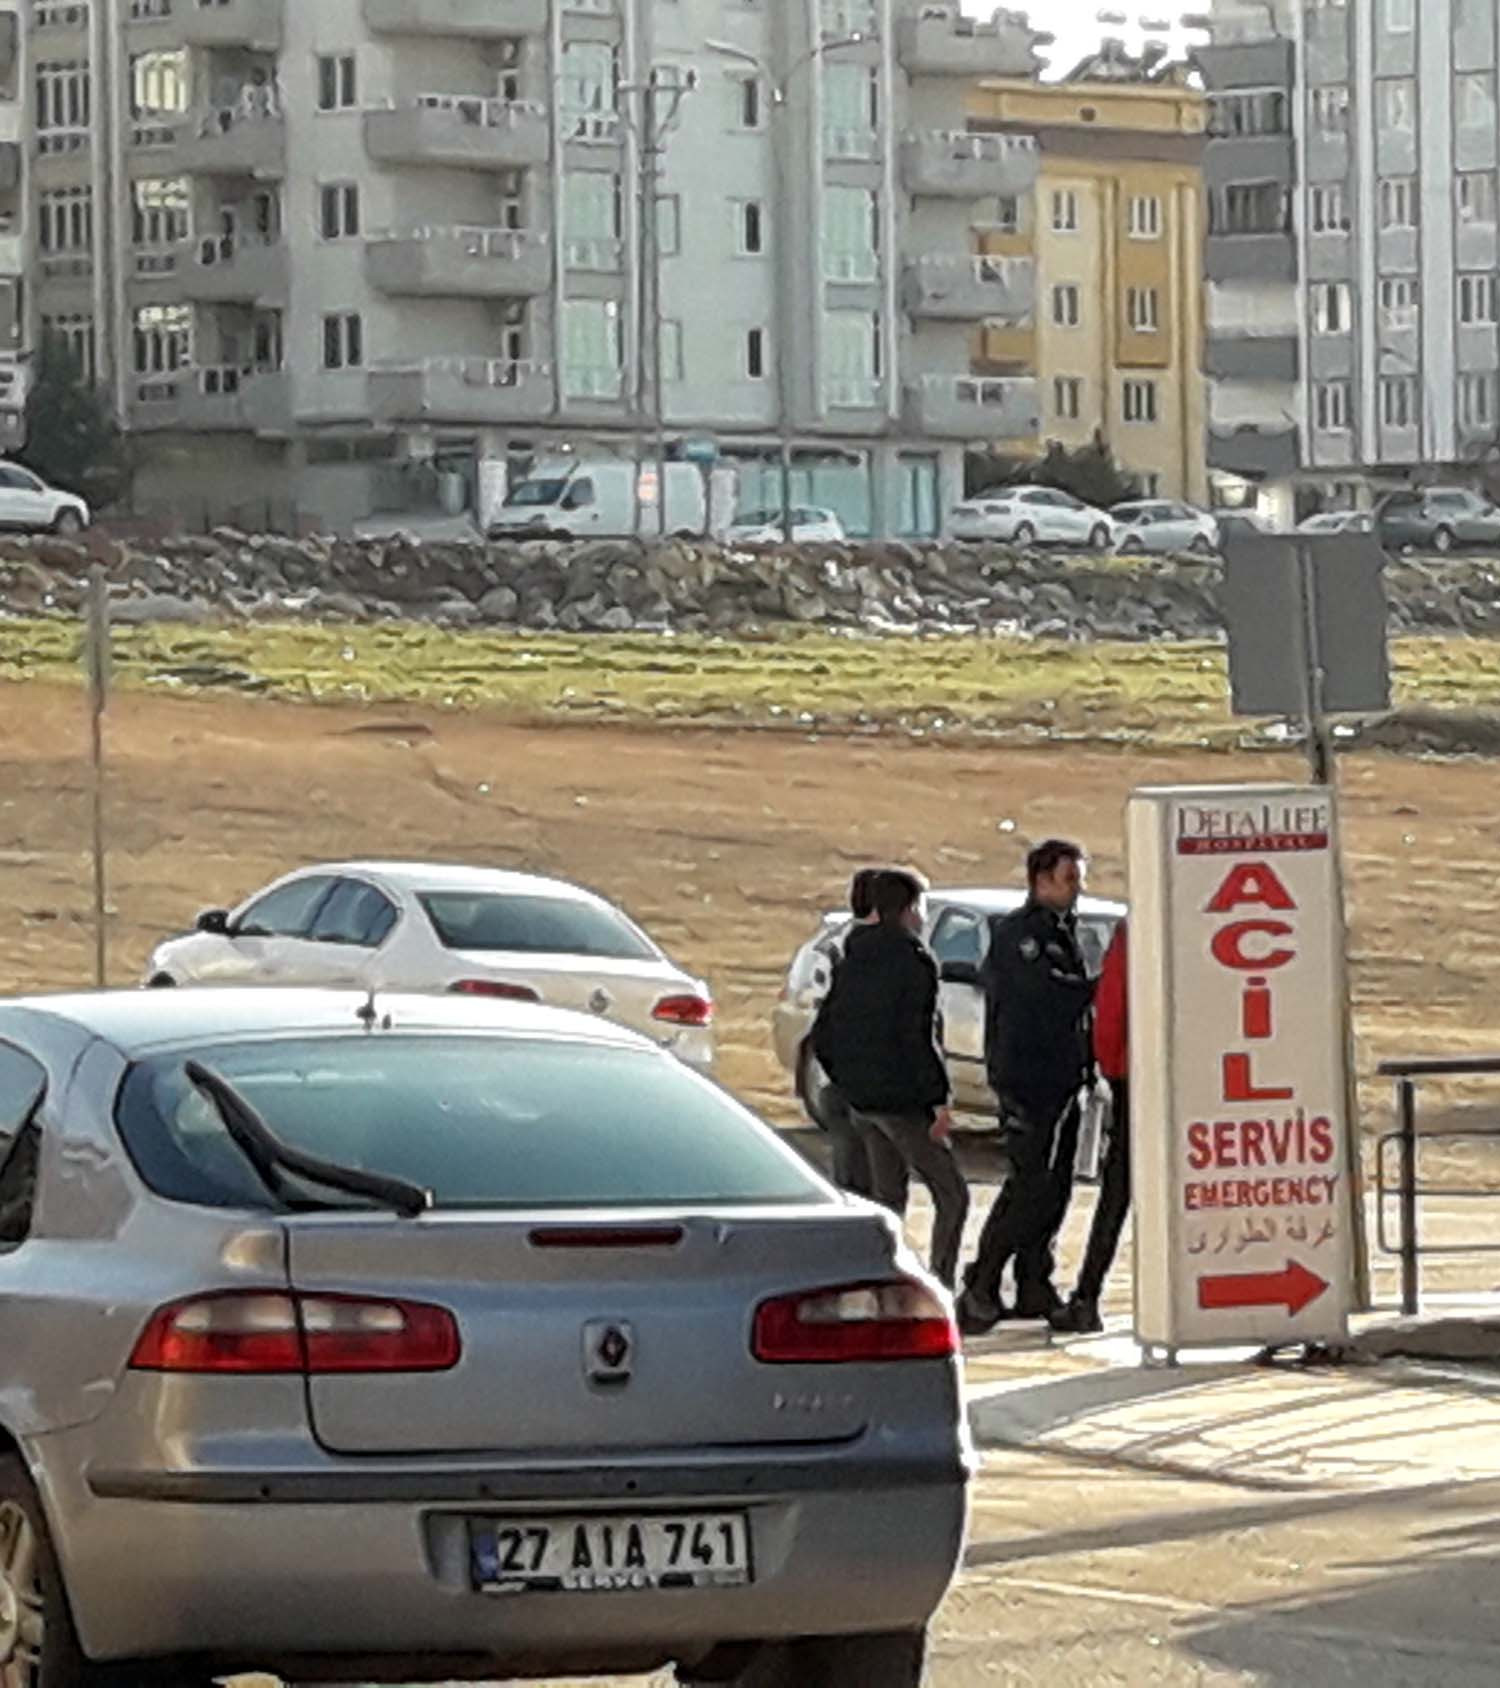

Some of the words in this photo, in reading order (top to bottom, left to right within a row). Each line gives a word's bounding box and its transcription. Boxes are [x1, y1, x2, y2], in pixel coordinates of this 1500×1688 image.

[1187, 1106, 1335, 1170] SERVİS
[1184, 1173, 1340, 1210] EMERGENCY
[499, 1526, 549, 1571] 27
[571, 1522, 646, 1568] AIA
[664, 1522, 735, 1566] 741
